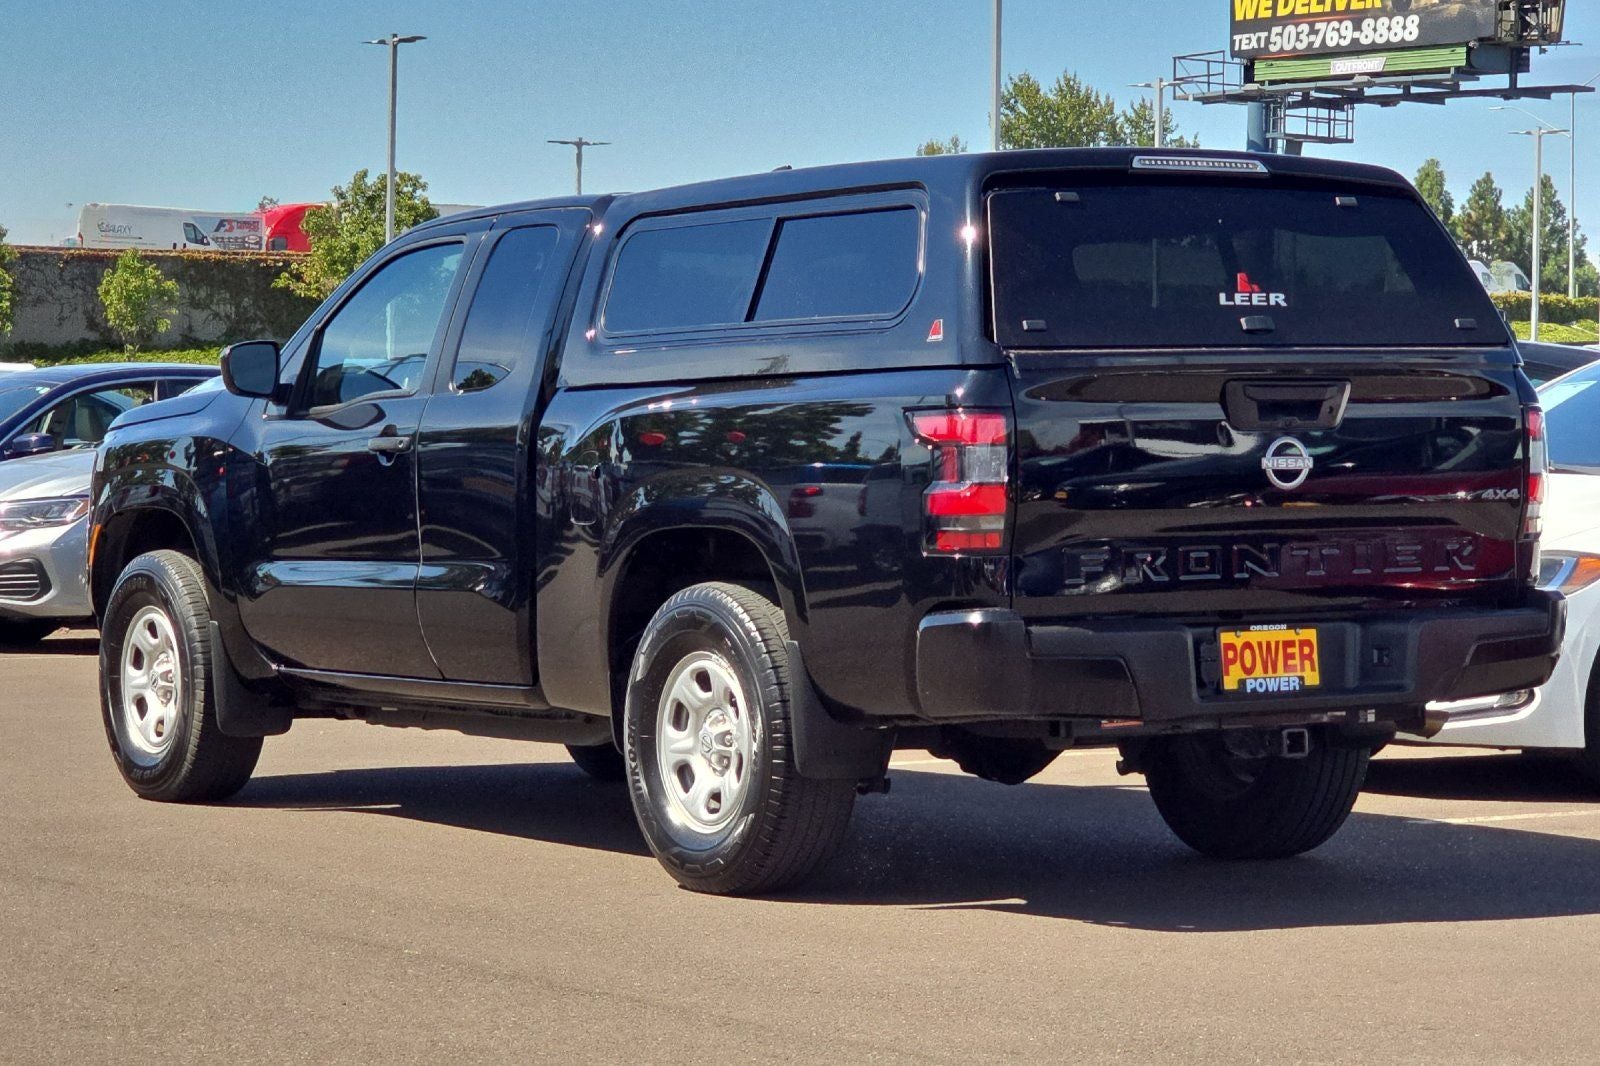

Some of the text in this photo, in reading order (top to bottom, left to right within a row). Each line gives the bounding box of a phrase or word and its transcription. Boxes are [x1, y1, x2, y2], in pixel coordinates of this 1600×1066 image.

[1234, 0, 1272, 21] WE
[1233, 14, 1420, 53] TEXT 503-769-8888
[1335, 60, 1381, 72] OUTFRONT
[1219, 292, 1288, 307] LEER
[1262, 457, 1313, 469] NISSAN
[1062, 537, 1477, 585] FRONTIER
[1222, 639, 1317, 677] POWER
[1245, 677, 1300, 693] POWER
